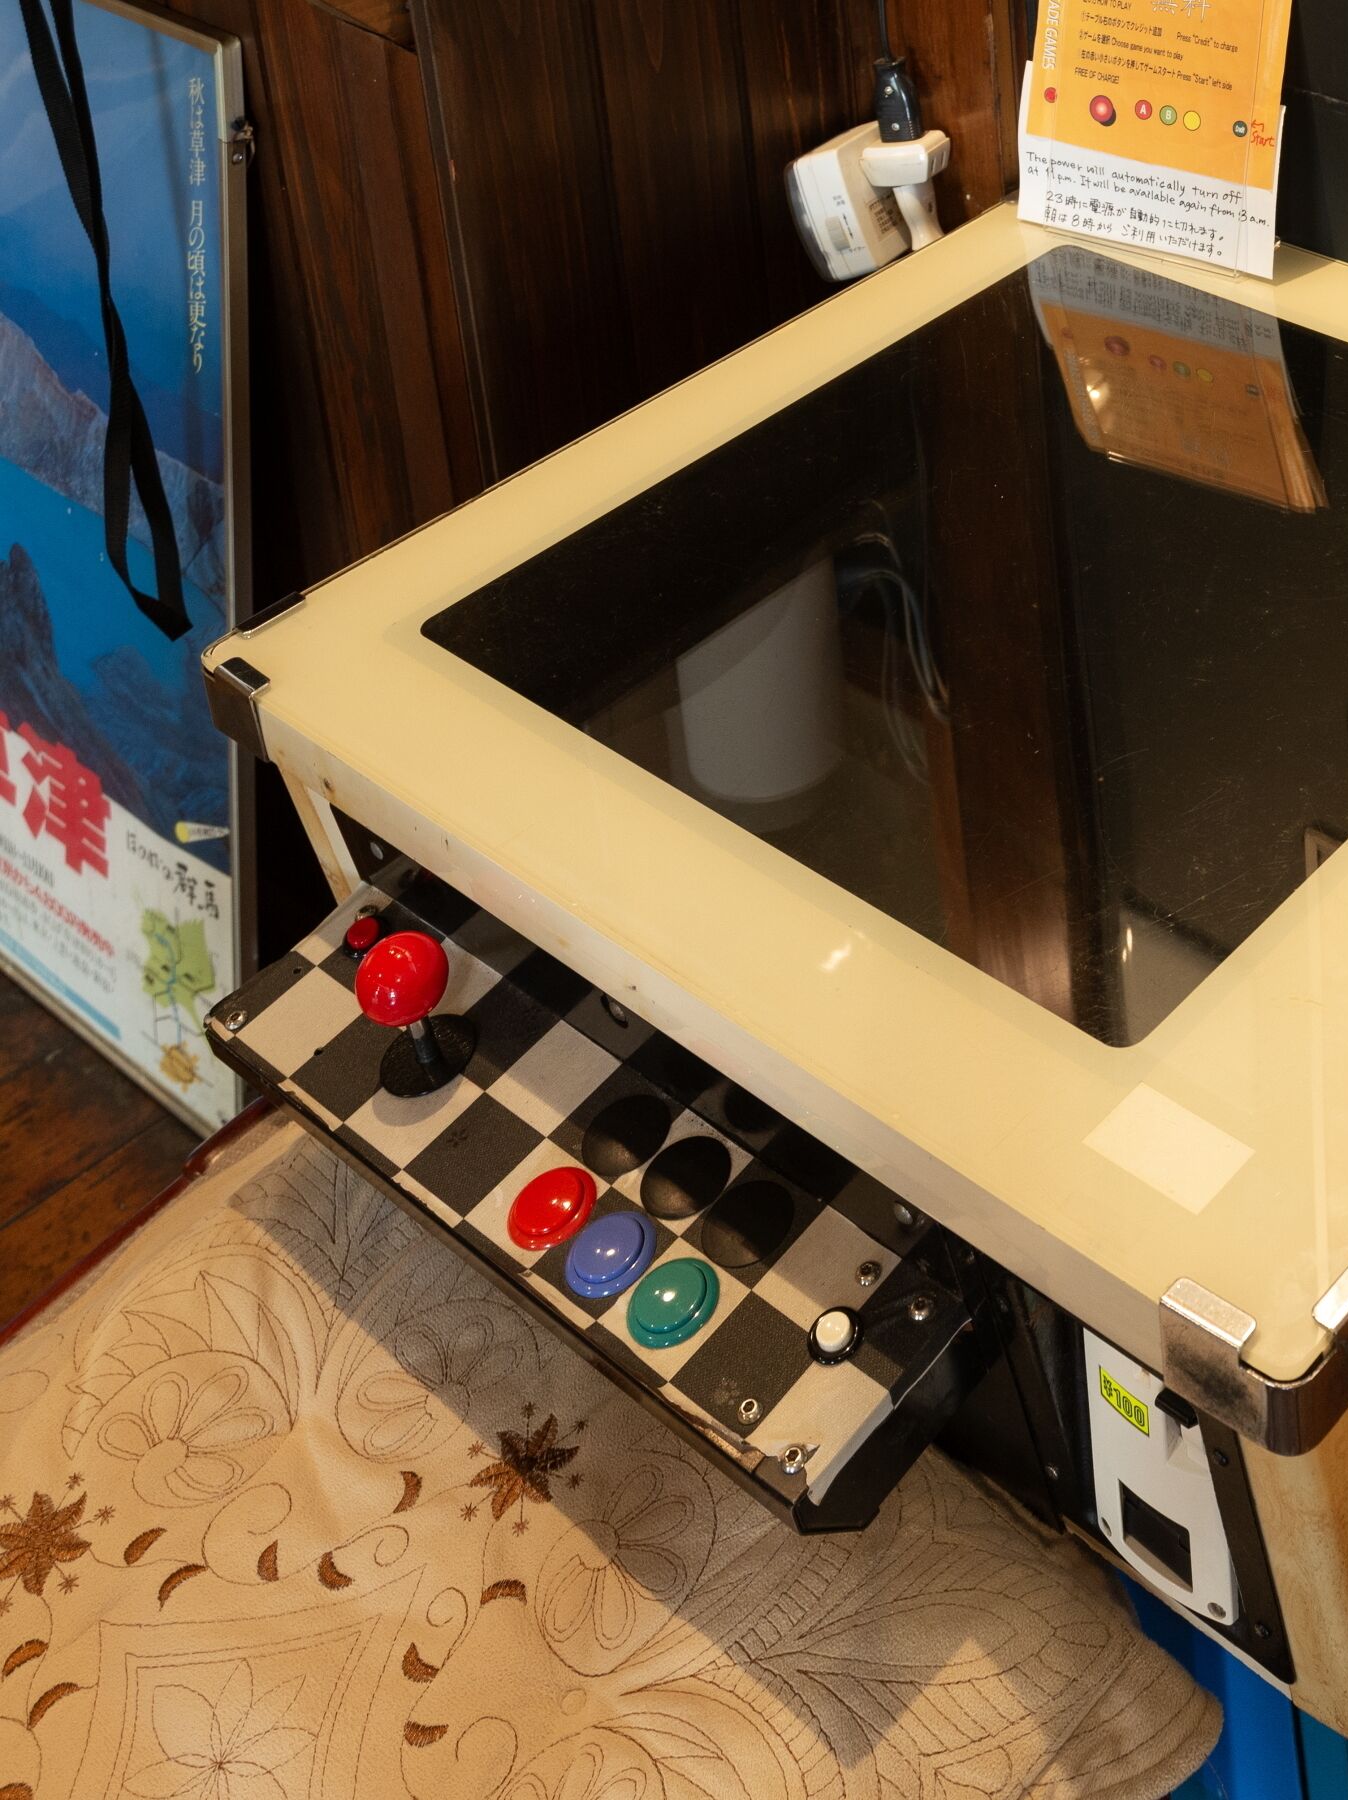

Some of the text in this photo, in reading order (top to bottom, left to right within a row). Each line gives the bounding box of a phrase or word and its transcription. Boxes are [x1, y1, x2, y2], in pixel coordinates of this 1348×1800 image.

[1117, 0, 1132, 10] PLAY
[1042, 0, 1061, 70] ADE GAMES
[1176, 31, 1191, 43] Press
[1213, 41, 1220, 49] to
[1220, 41, 1238, 53] charge
[1111, 37, 1129, 49] Choose
[1130, 43, 1143, 52] game
[1143, 45, 1152, 54] you
[1153, 48, 1165, 57] want
[1166, 50, 1173, 58] to
[1173, 52, 1183, 61] play
[1074, 66, 1088, 78] FREE
[1088, 70, 1097, 79] OF
[1176, 70, 1192, 82] Press
[1212, 78, 1221, 88] left
[1222, 80, 1232, 91] side
[1139, 103, 1147, 115] A
[1164, 109, 1172, 121] B
[1250, 130, 1275, 147] Start
[1026, 151, 1243, 205] The power will automatically turn off
[1027, 166, 1039, 177] at
[1057, 173, 1077, 185] p.m.
[1093, 180, 1110, 190] will
[1113, 182, 1126, 193] be
[1129, 187, 1176, 206] available
[1179, 200, 1207, 213] again
[1208, 204, 1235, 217] from
[1249, 215, 1270, 227] a.m.
[1102, 1374, 1145, 1428] ¥100
